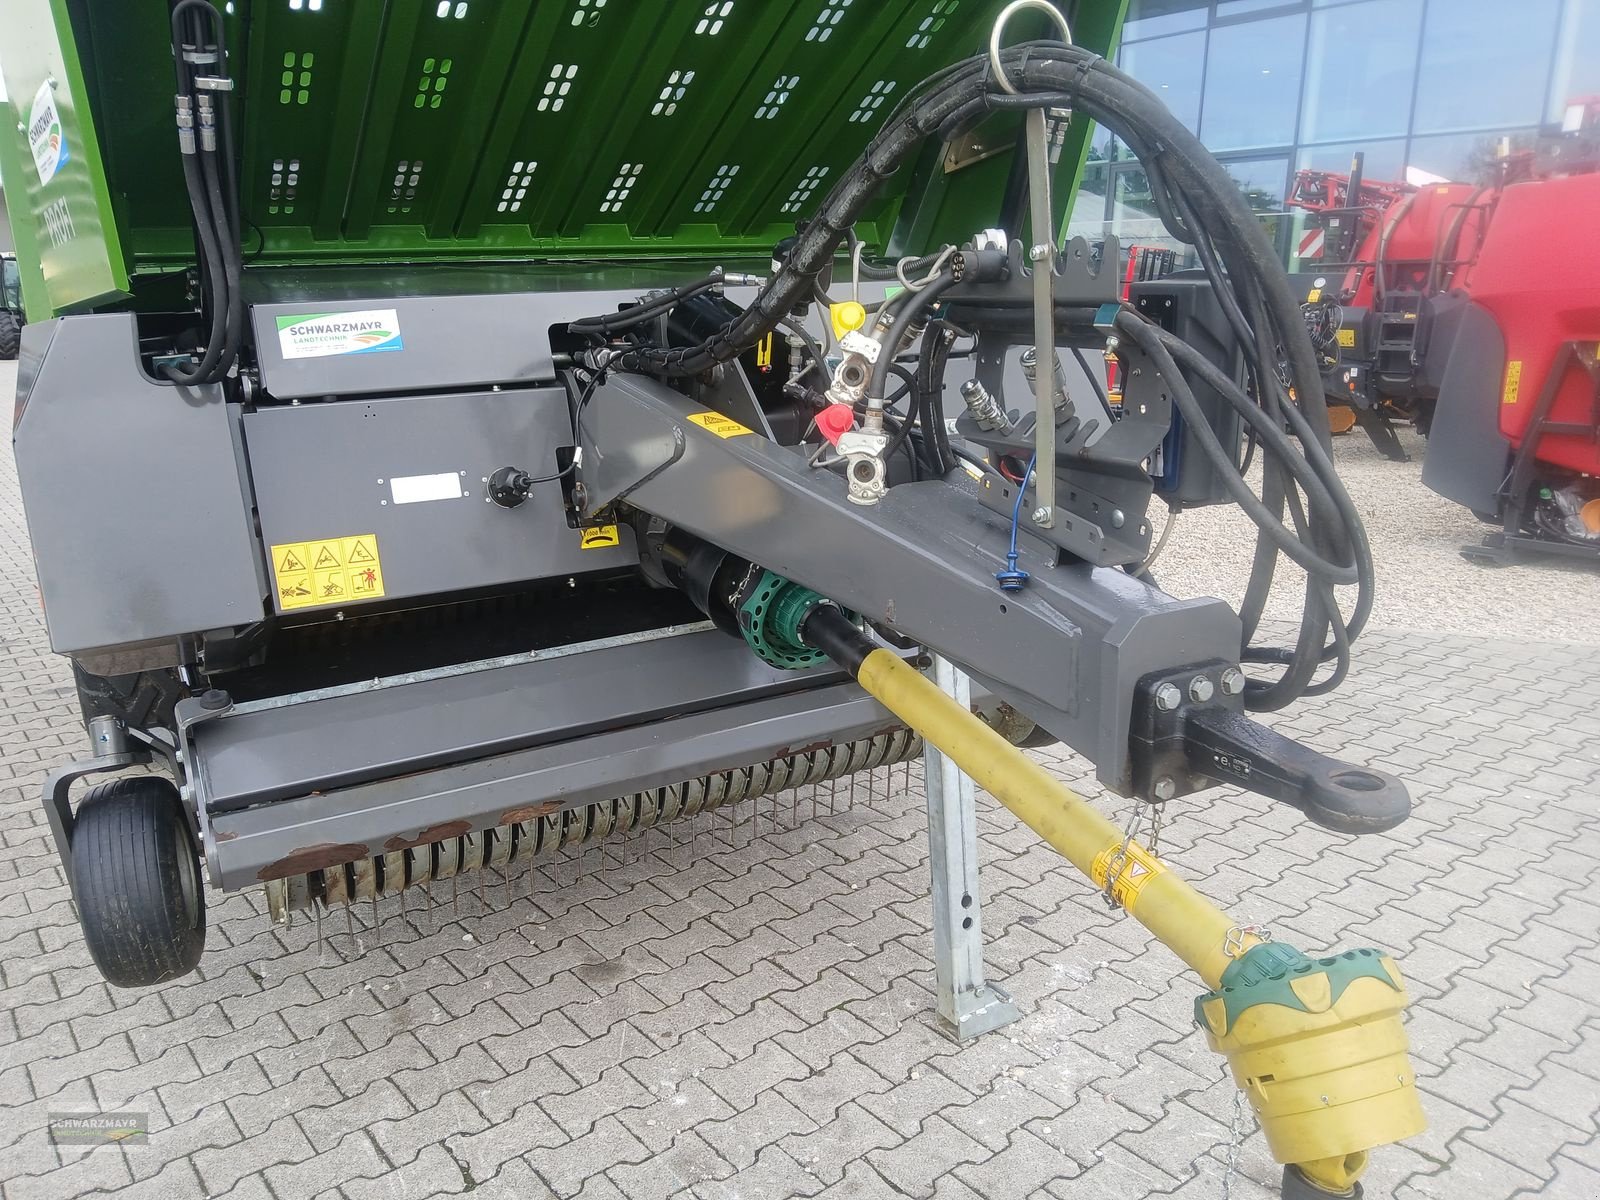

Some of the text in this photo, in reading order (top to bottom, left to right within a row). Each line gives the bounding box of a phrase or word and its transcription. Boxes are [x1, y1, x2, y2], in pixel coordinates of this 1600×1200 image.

[43, 195, 76, 249] PROFI
[290, 321, 382, 336] SCHWARZMAYR
[293, 335, 348, 344] LANDTECHNIK
